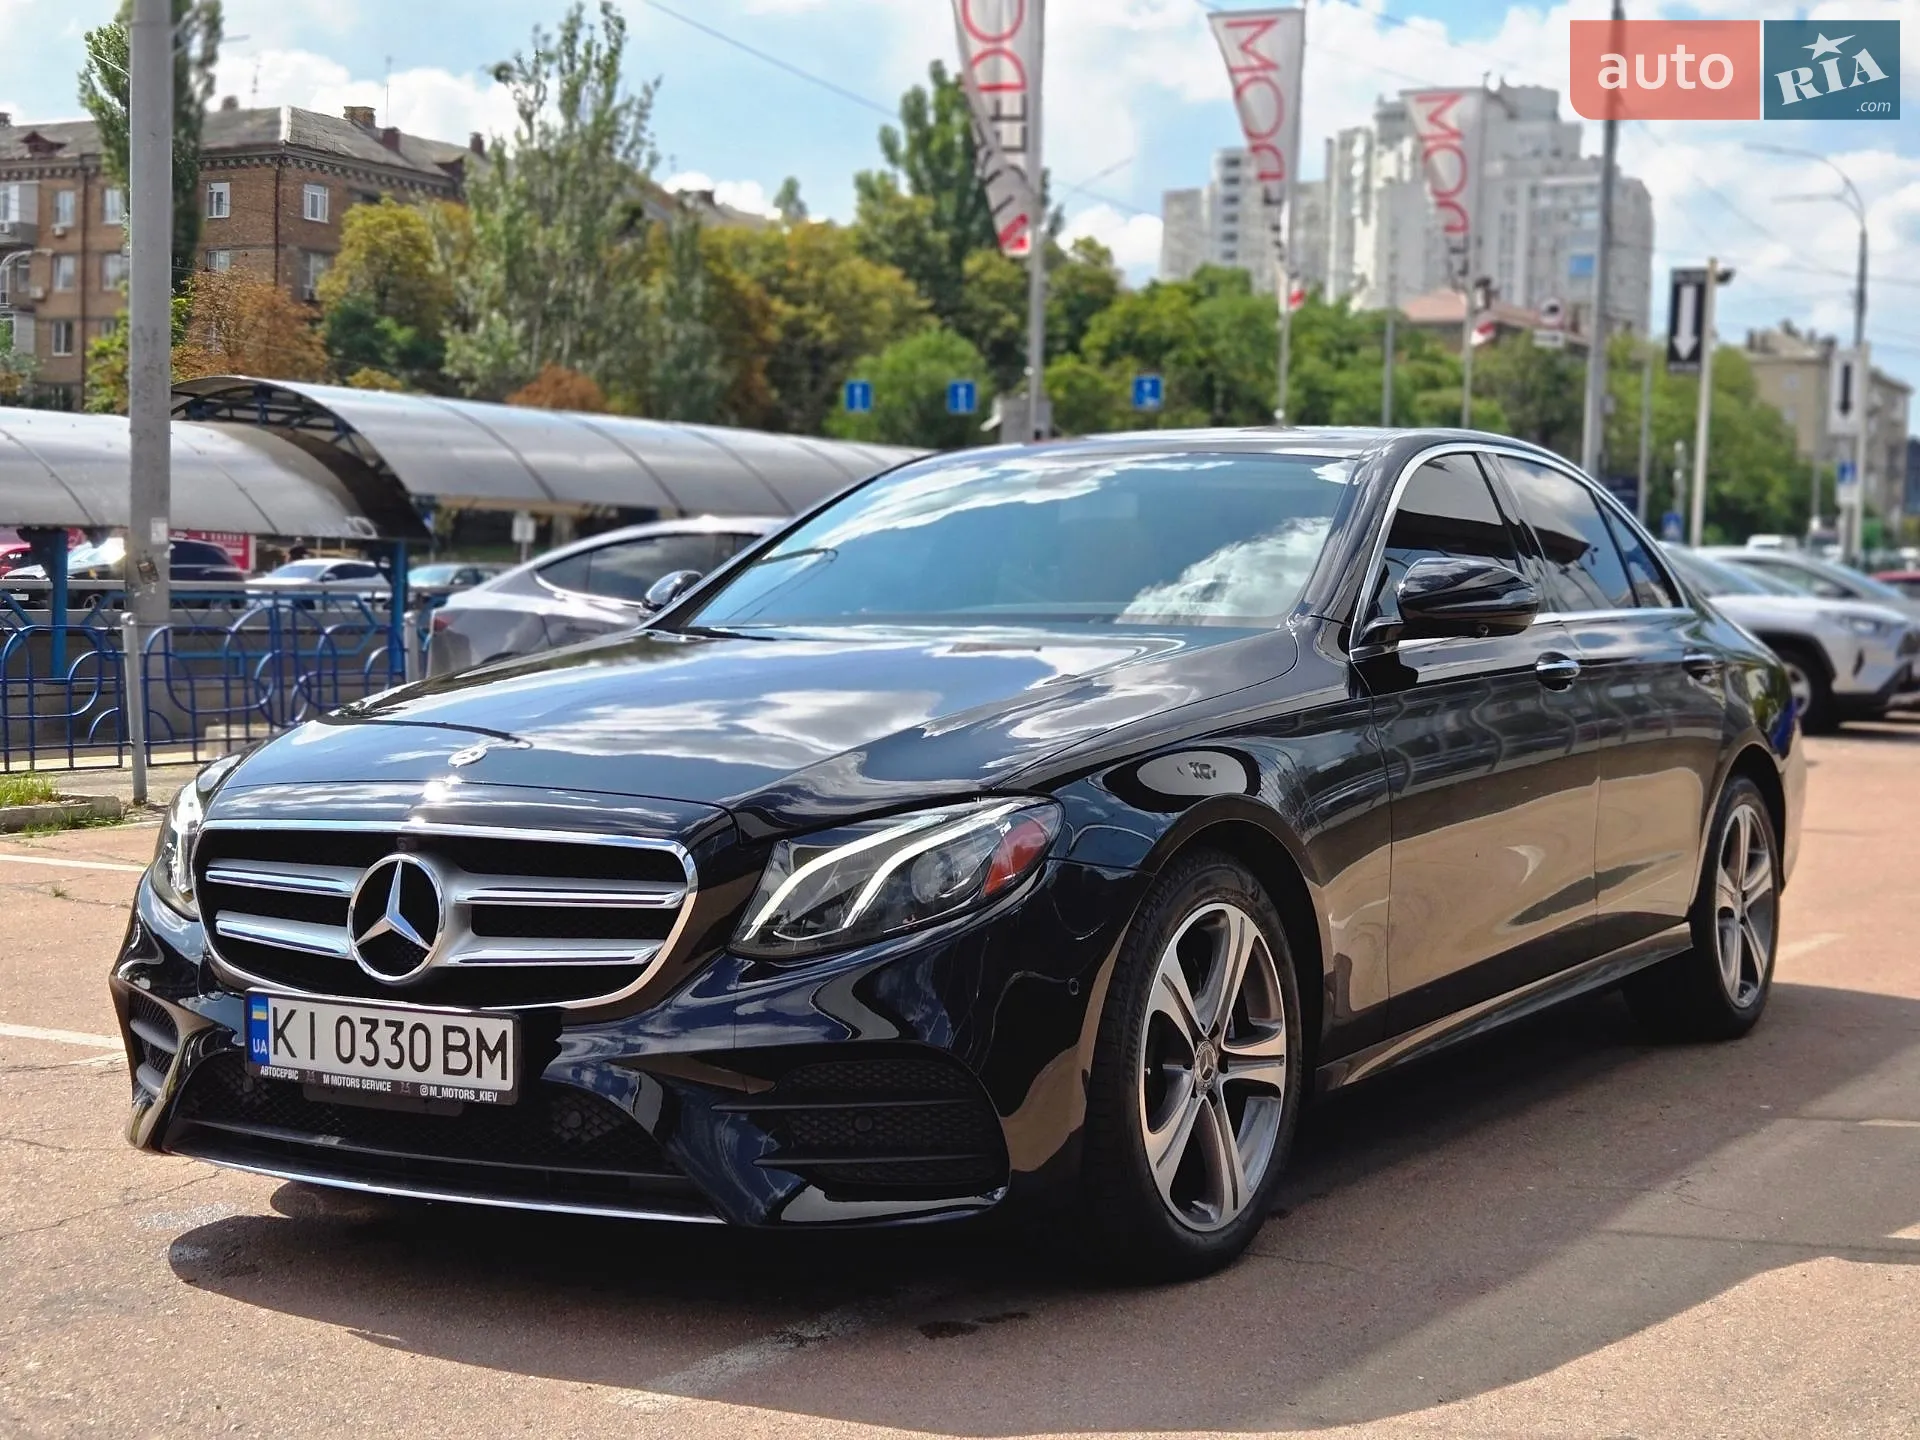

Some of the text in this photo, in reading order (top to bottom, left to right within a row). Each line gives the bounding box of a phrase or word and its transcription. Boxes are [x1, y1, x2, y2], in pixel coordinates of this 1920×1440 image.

[252, 1037, 268, 1056] UA
[272, 1006, 508, 1081] KI 0330 BM
[260, 1065, 299, 1081] АВТОСЕРВІС
[331, 1075, 361, 1089] MOTORS
[361, 1079, 392, 1093] SERVICE
